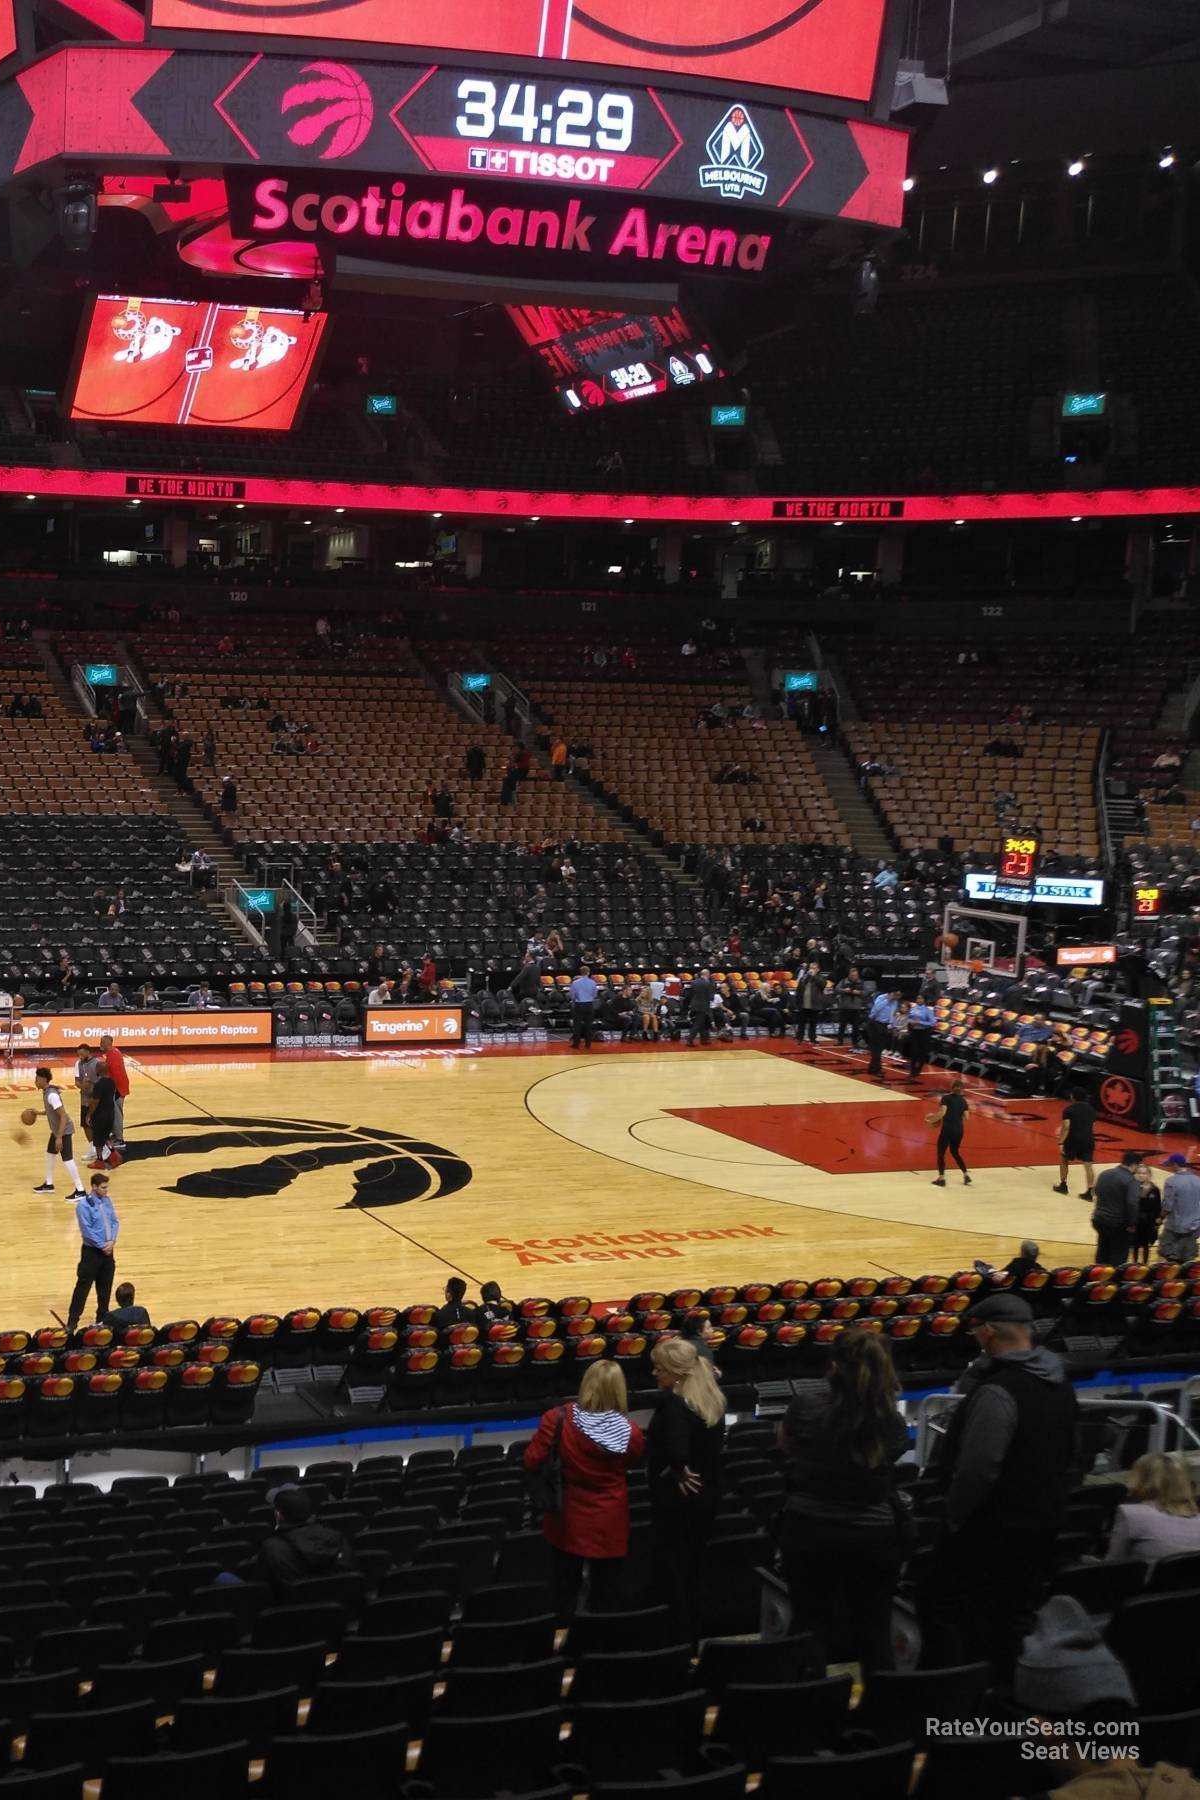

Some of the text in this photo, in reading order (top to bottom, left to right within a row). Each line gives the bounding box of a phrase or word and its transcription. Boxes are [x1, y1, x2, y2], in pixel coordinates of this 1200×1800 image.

[455, 79, 635, 151] 34:29
[704, 170, 762, 189] MELBOURNE
[252, 178, 771, 272] Scotiabank Arena
[138, 479, 234, 497] WE THE NORTH
[786, 502, 891, 516] WE THE NORTH
[229, 592, 248, 602] 120
[580, 601, 597, 612] 121
[91, 668, 112, 683] Sprite
[1006, 853, 1030, 875] 23
[1050, 886, 1087, 897] STAR
[62, 1025, 258, 1038] The Official Bank of the Toronto Raptors
[370, 1020, 424, 1034] Tangerine
[325, 1047, 477, 1058] Tangerine
[1189, 1097, 1200, 1118] L
[486, 1222, 791, 1252] Scotiabank
[516, 1243, 684, 1267] Arena
